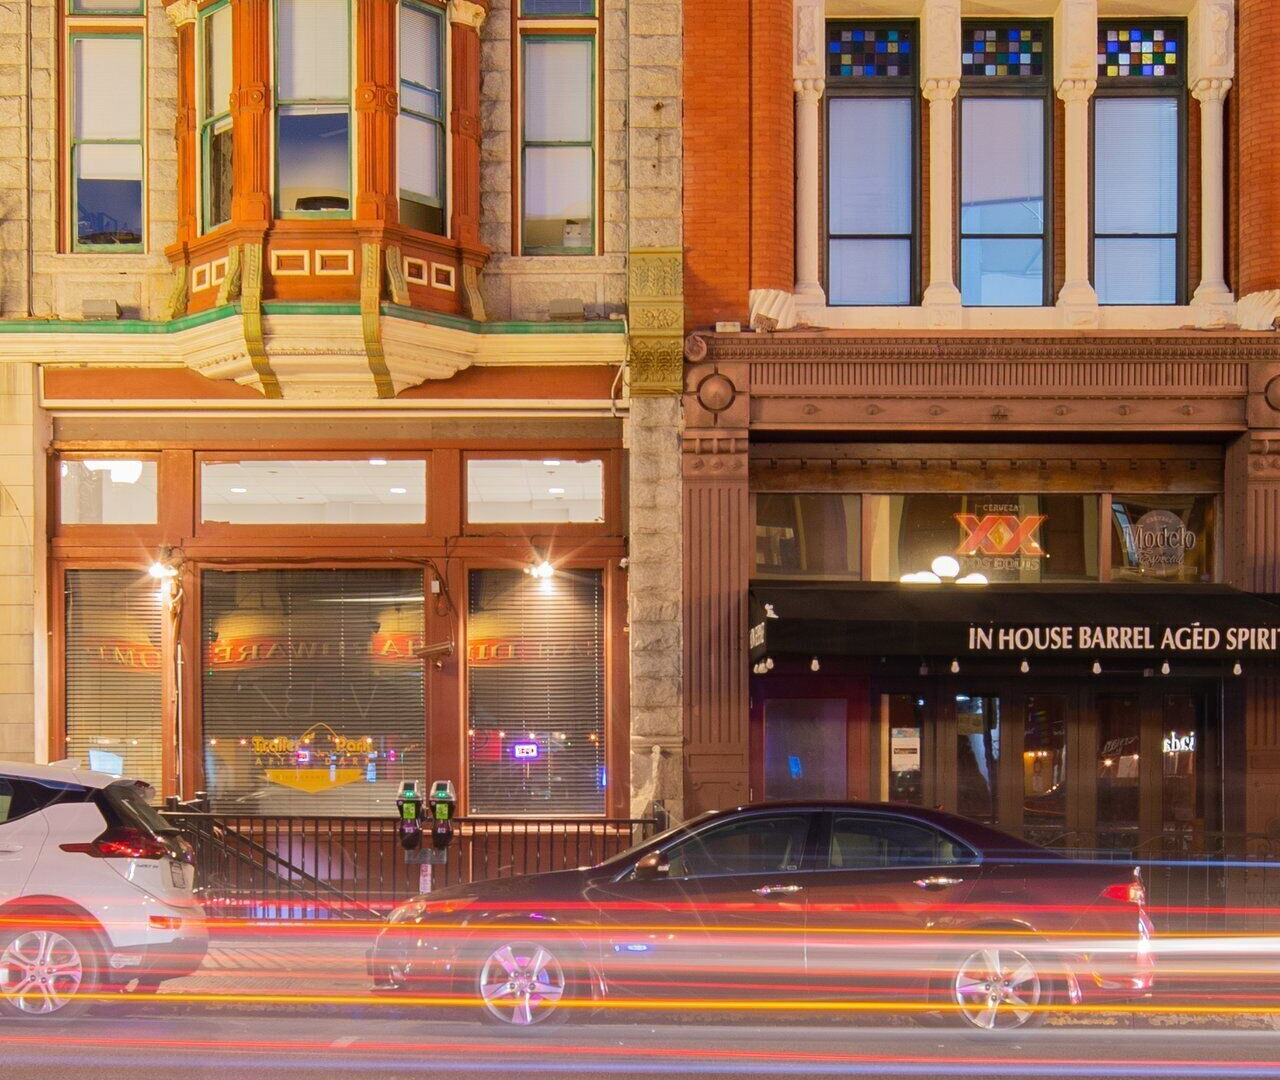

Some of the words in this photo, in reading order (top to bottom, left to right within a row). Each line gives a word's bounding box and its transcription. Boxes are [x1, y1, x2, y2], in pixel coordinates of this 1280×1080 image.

[1125, 524, 1196, 551] Modelo
[969, 627, 993, 649] IN
[998, 627, 1072, 650] HOUSE
[1079, 626, 1154, 649] BARREL
[335, 735, 372, 753] Park
